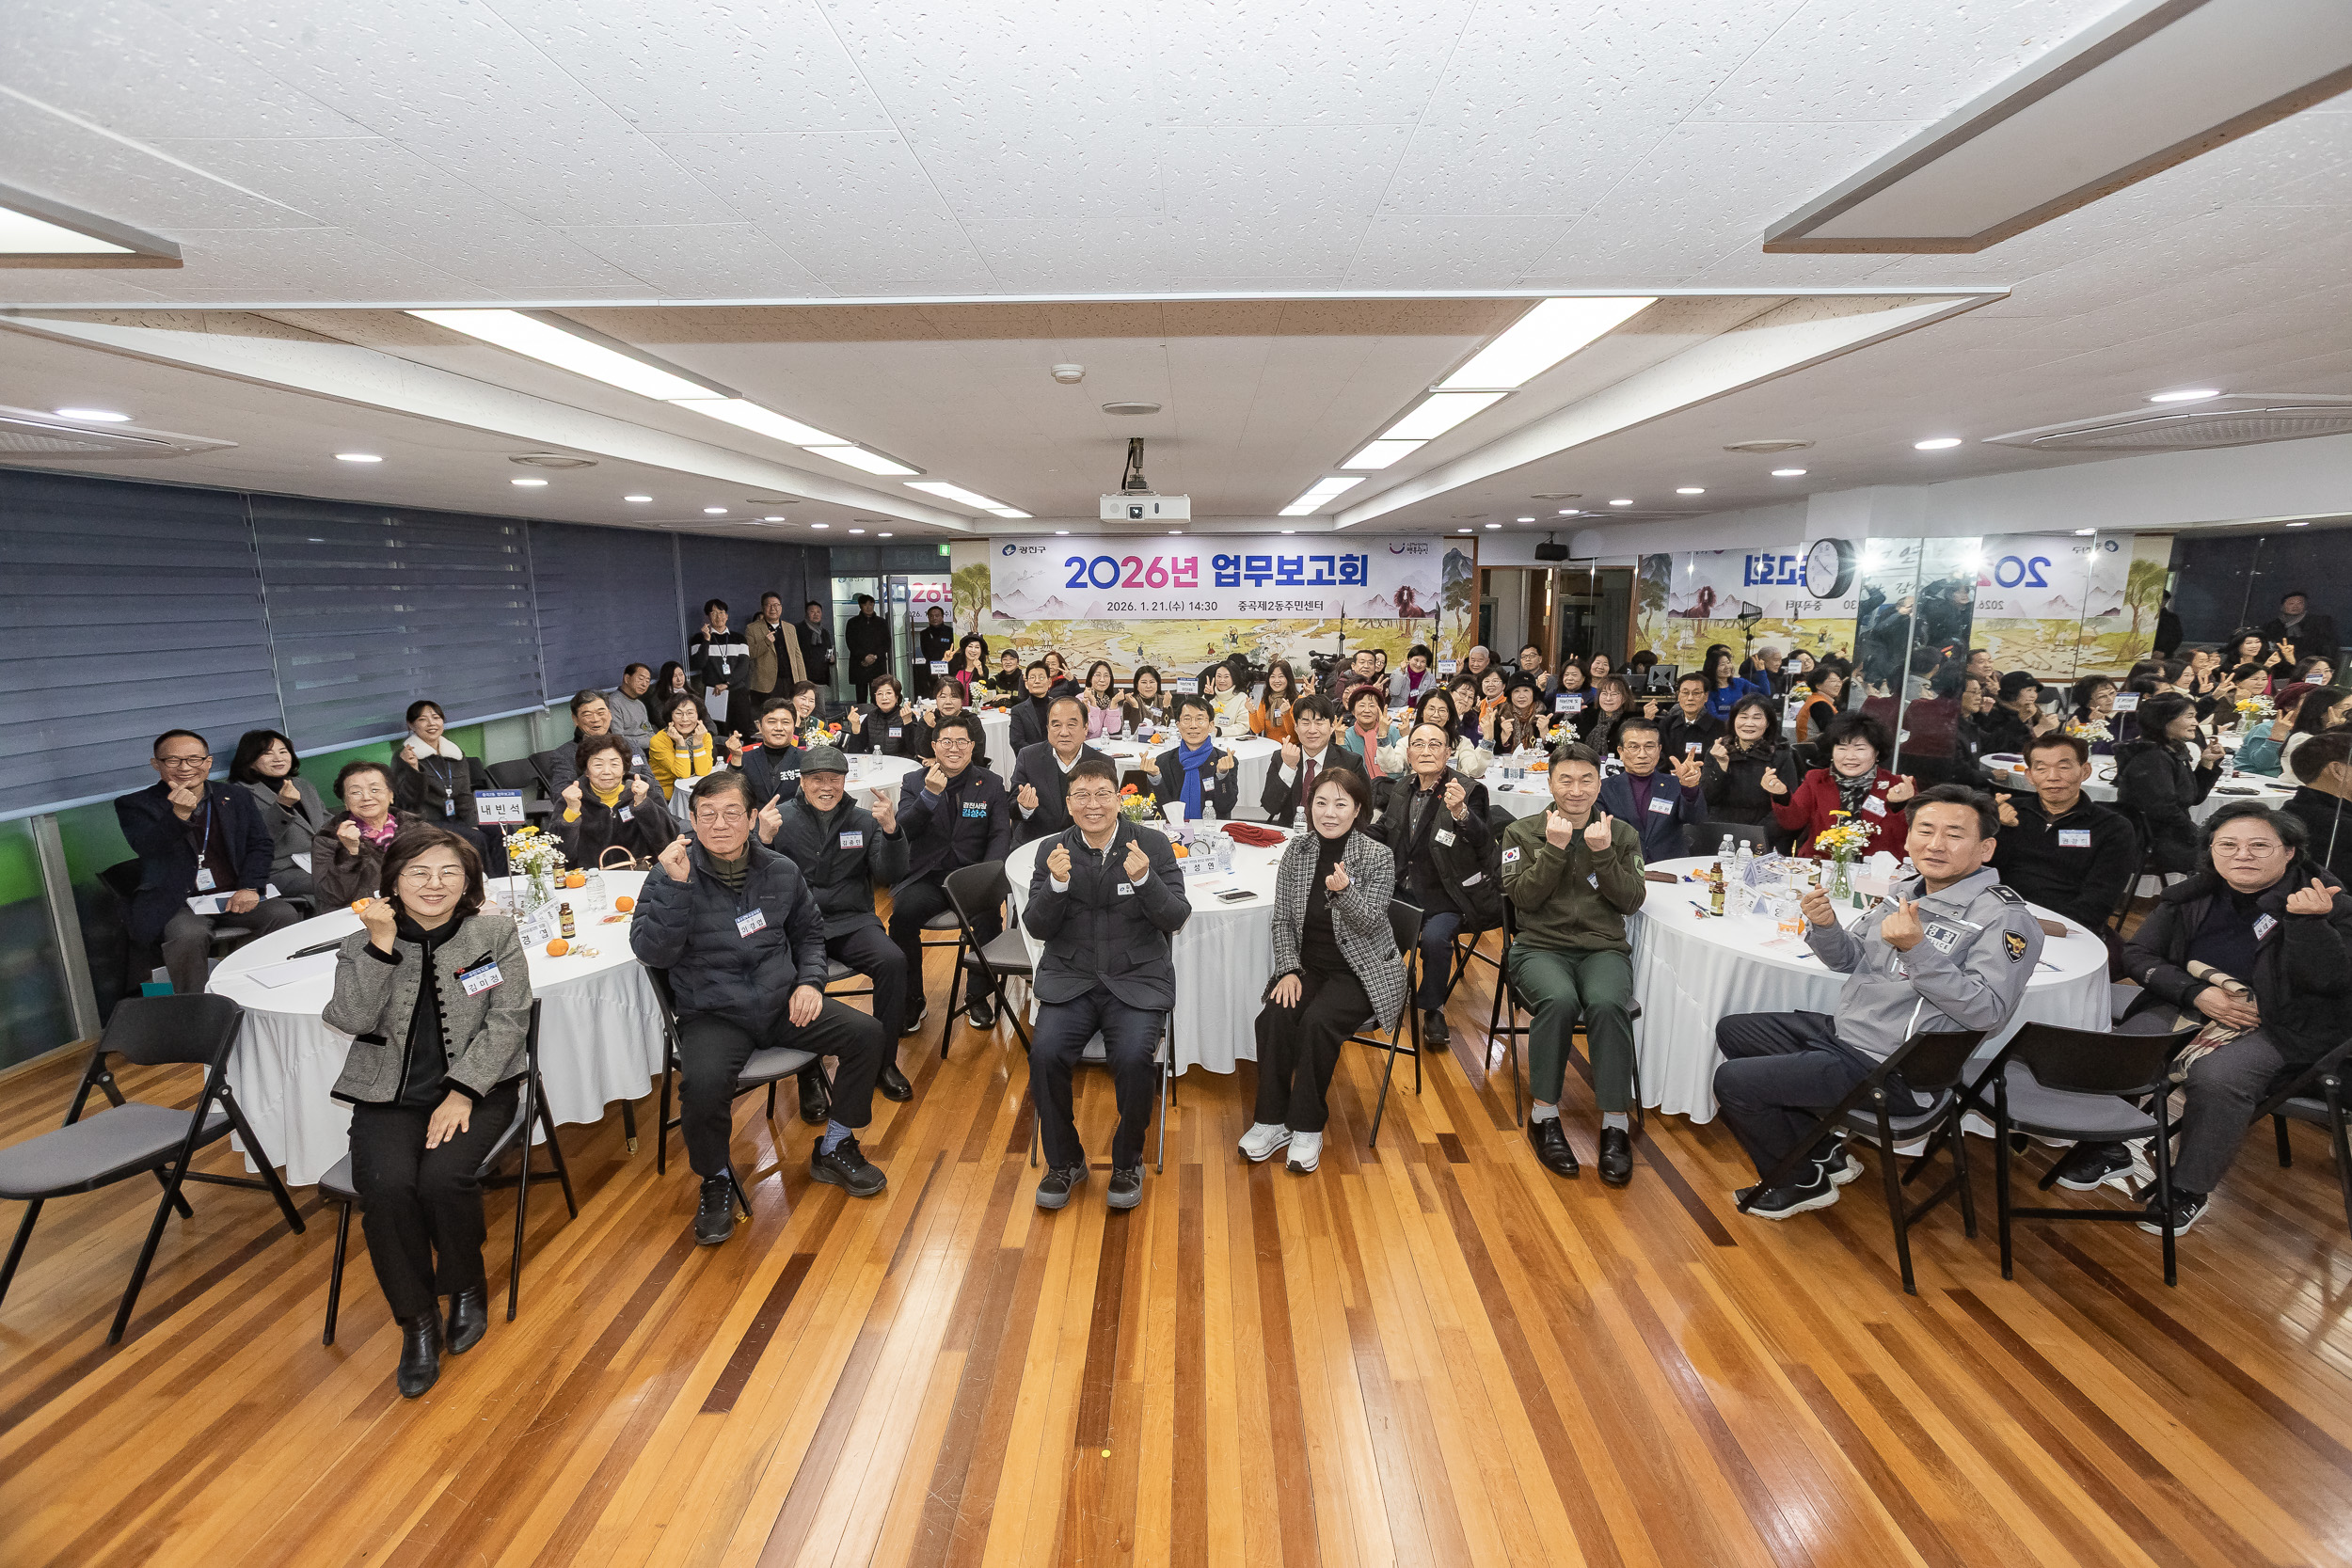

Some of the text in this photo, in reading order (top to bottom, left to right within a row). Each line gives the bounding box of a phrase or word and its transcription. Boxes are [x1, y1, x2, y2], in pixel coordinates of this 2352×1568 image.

[1018, 546, 1046, 554] 광진구
[1065, 553, 1369, 589] 2026년 업무보고회
[1107, 601, 1136, 611] 2026.
[1190, 601, 1218, 611] 14:30
[1238, 600, 1324, 612] 중곡제2동주민센터
[480, 804, 520, 816] 내빈석
[1927, 925, 1956, 943] 경찰
